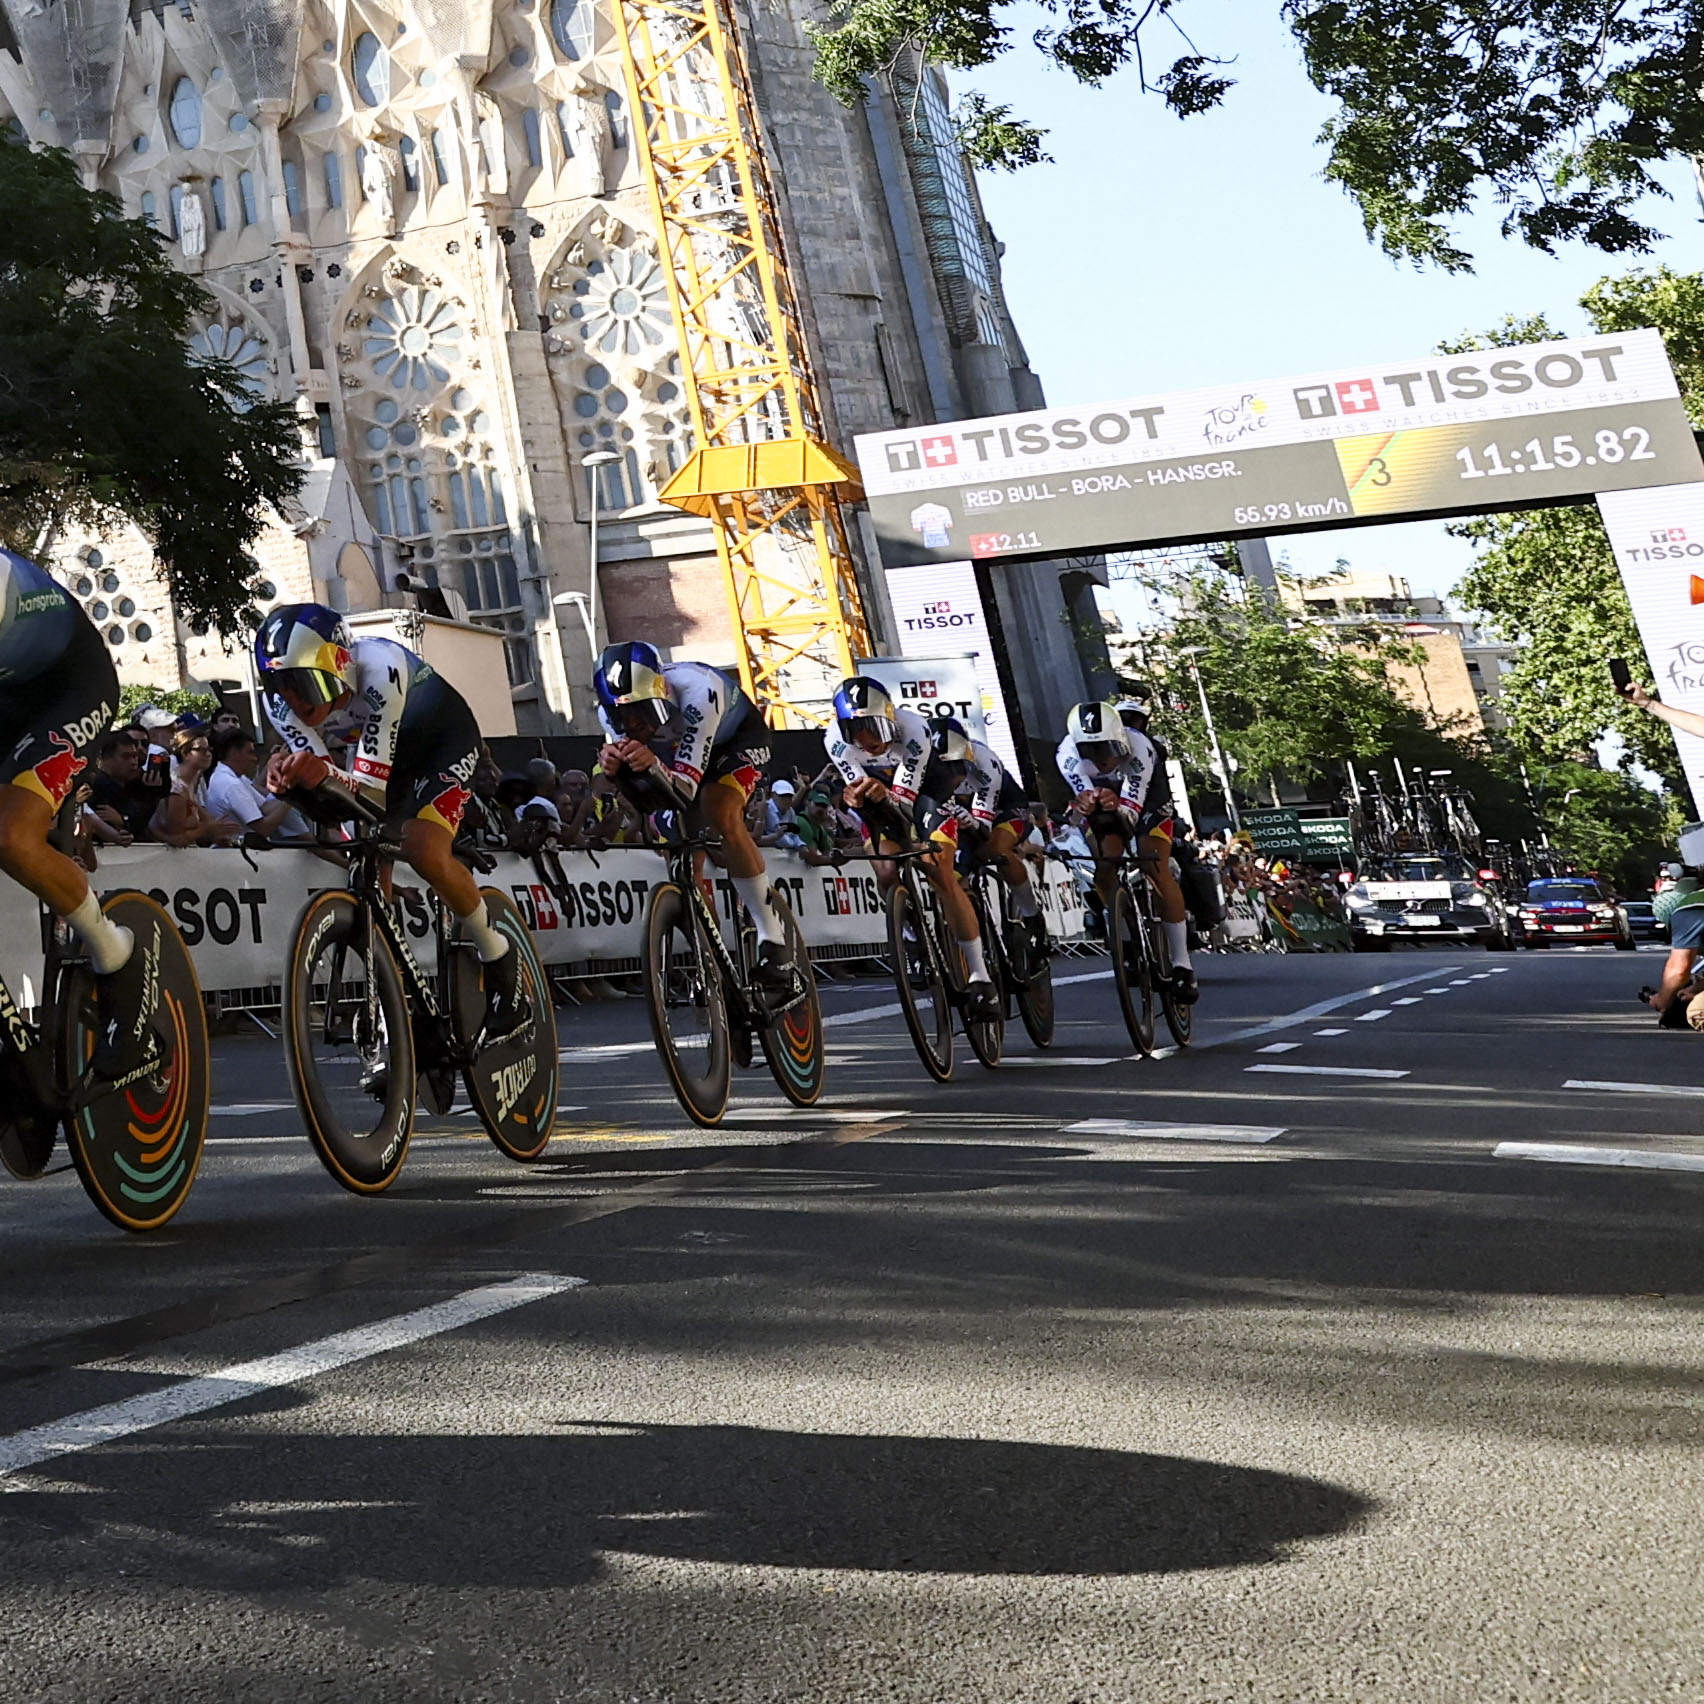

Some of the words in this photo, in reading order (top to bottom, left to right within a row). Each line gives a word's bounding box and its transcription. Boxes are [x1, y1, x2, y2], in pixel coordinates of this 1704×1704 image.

[1384, 345, 1624, 407] TISSOT
[962, 406, 1165, 461] TISSOT
[1370, 458, 1392, 487] 3
[1455, 425, 1655, 480] 11:15.82
[966, 489, 1004, 508] RED
[1008, 483, 1056, 503] BULL
[1072, 475, 1131, 495] BORA
[1148, 460, 1242, 486] HANSGR.
[1296, 498, 1348, 518] km/h
[17, 589, 66, 614] hansgrohe
[904, 613, 975, 631] TISSOT
[63, 701, 112, 748] BORA
[363, 714, 382, 756] BOSS
[491, 1053, 537, 1124] OUTRIDE
[381, 1098, 409, 1171] roval
